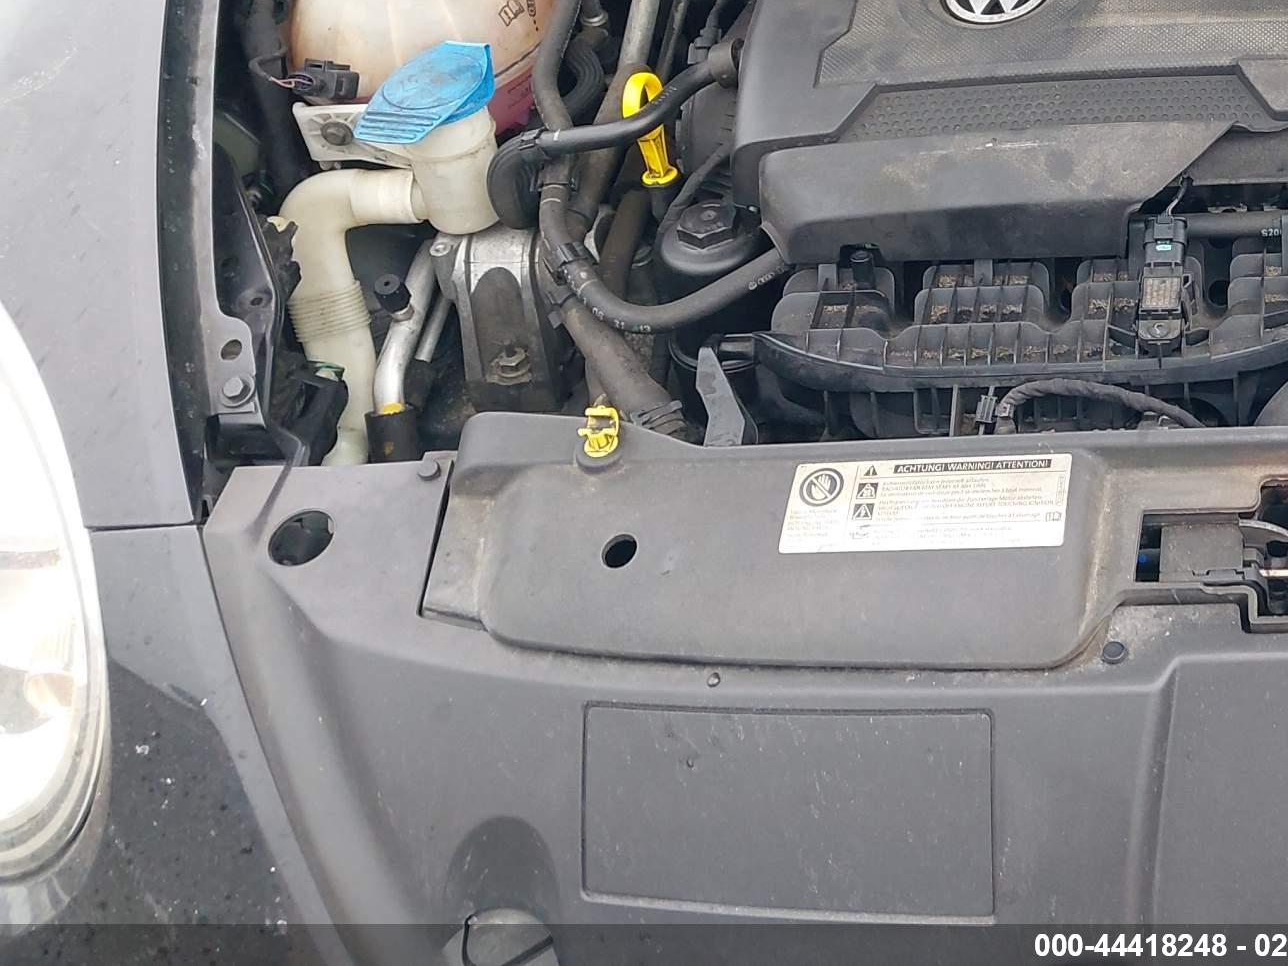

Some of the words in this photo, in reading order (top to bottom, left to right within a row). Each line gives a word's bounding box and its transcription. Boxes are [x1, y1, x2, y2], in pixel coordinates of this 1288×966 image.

[897, 464, 945, 473] ACHTUNG!
[948, 462, 994, 472] WARNING!
[996, 460, 1049, 469] ATTENTION!
